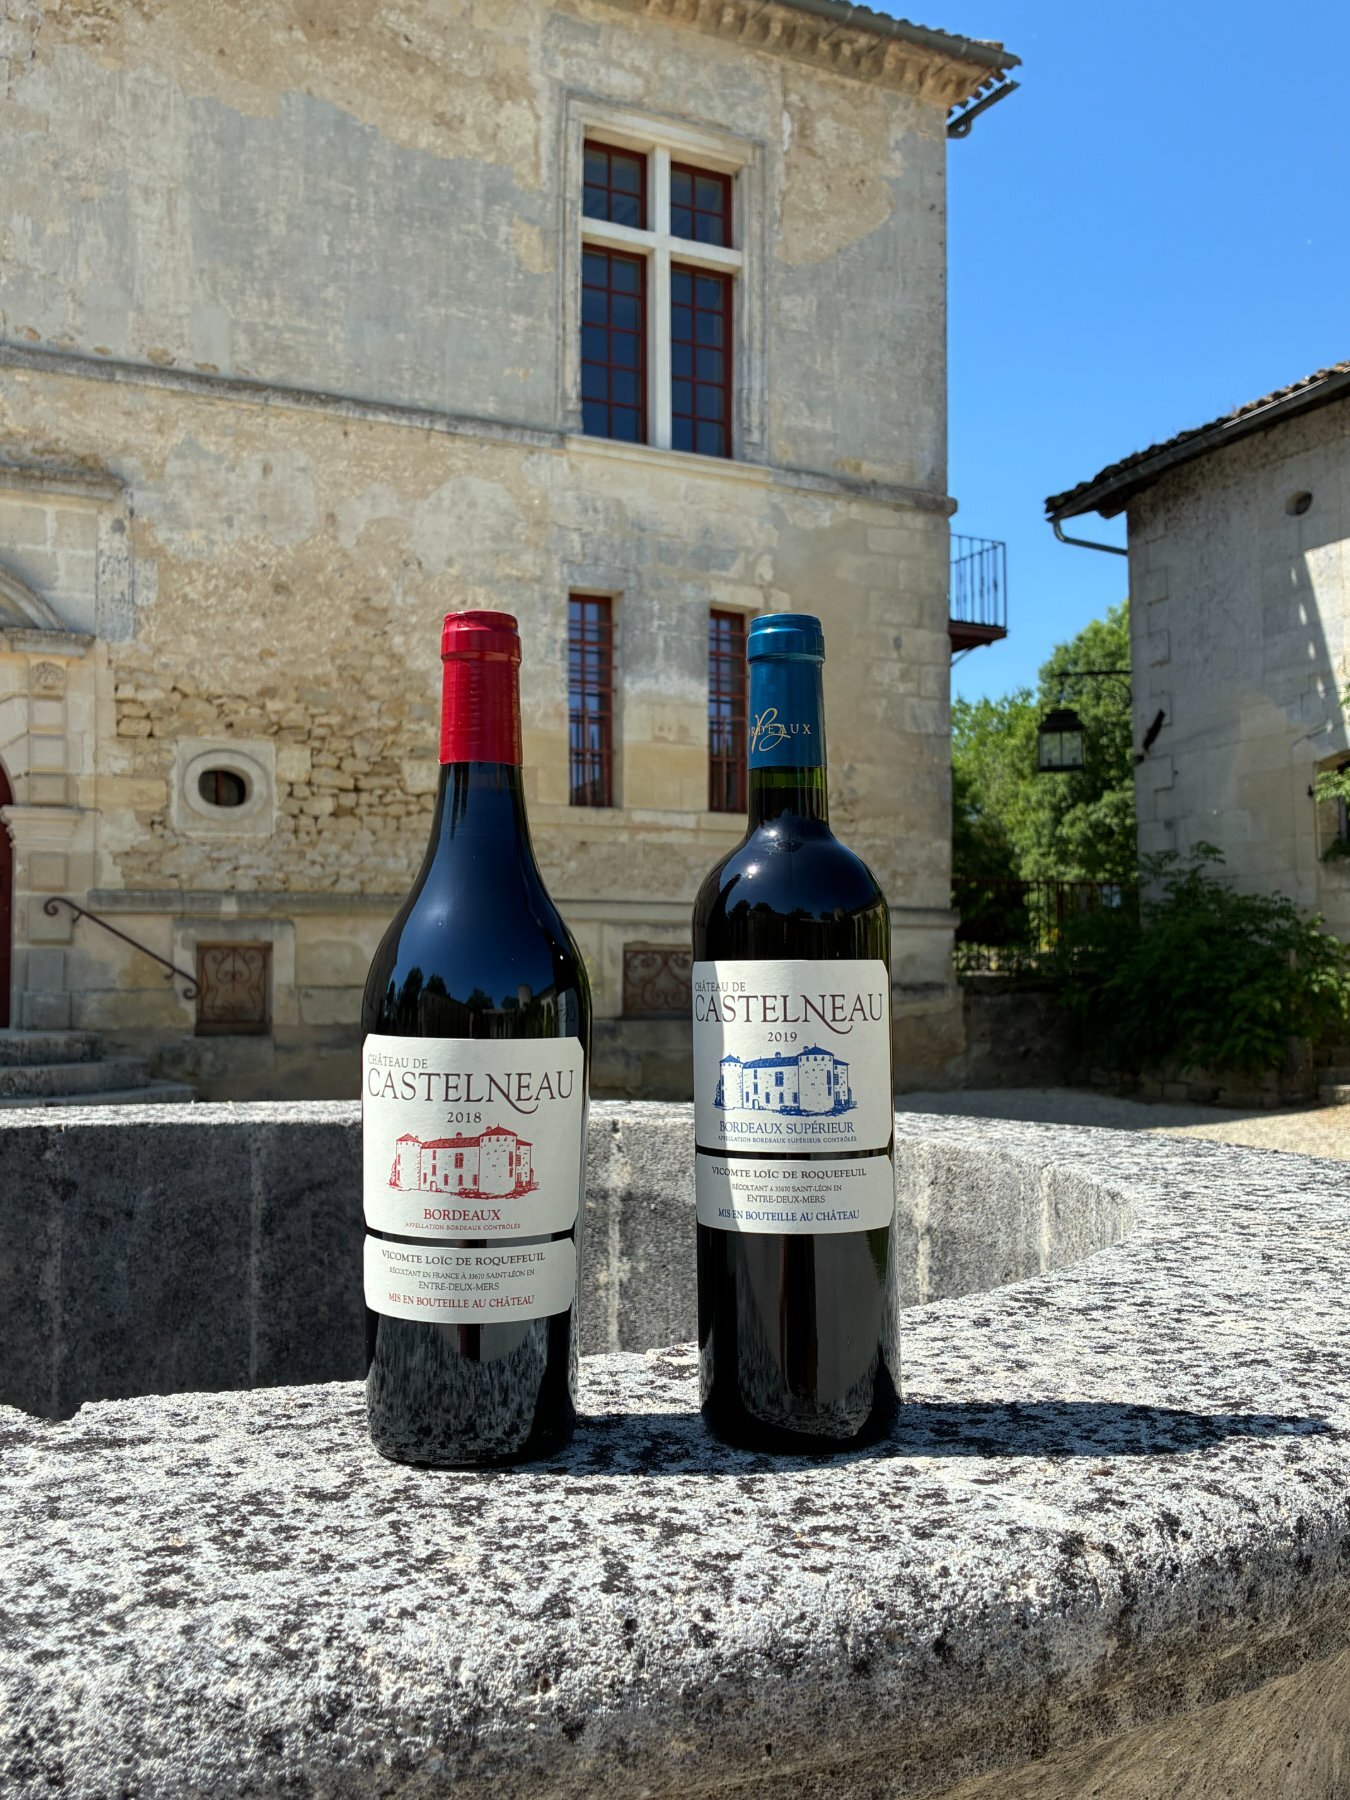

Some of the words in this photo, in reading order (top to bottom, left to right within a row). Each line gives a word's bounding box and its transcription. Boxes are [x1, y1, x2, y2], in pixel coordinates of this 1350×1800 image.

[695, 981, 728, 992] CHÂTEAU
[732, 982, 746, 992] DE
[695, 994, 882, 1034] CASTELNEAU
[767, 1032, 797, 1042] 2019
[368, 1053, 409, 1068] CHÂTEAU
[413, 1058, 428, 1069] DE
[368, 1068, 574, 1114] CASTELNEAU
[447, 1112, 482, 1123] 2018
[720, 1121, 782, 1134] BORDEAUX
[786, 1120, 855, 1134] SUPÉRIEUR
[712, 1166, 750, 1178] VICOMTE
[754, 1169, 779, 1178] LOÏC
[801, 1168, 867, 1179] ROQUEFEUIL
[747, 1195, 825, 1203] ENTRE-DEUX-MERS
[424, 1208, 501, 1220] BORDEAUX
[719, 1208, 730, 1218] MIS
[732, 1210, 743, 1219] EN
[746, 1211, 797, 1221] BOUTEILLE
[800, 1212, 813, 1221] AU
[816, 1210, 860, 1221] CHÂTEAU
[382, 1250, 422, 1263] VICOMTE
[426, 1256, 452, 1265] LOÏC
[456, 1258, 471, 1266] DE
[476, 1253, 546, 1266] ROQUEFEUIL
[390, 1266, 421, 1278] RÉCOLTANT
[418, 1281, 499, 1291] ENTRE-DEUX-MERS
[388, 1292, 401, 1302] MIS
[403, 1295, 413, 1304] EN
[417, 1296, 469, 1308] BOUTEILLE
[472, 1299, 486, 1308] AU
[488, 1295, 534, 1308] CHÂTEAU
